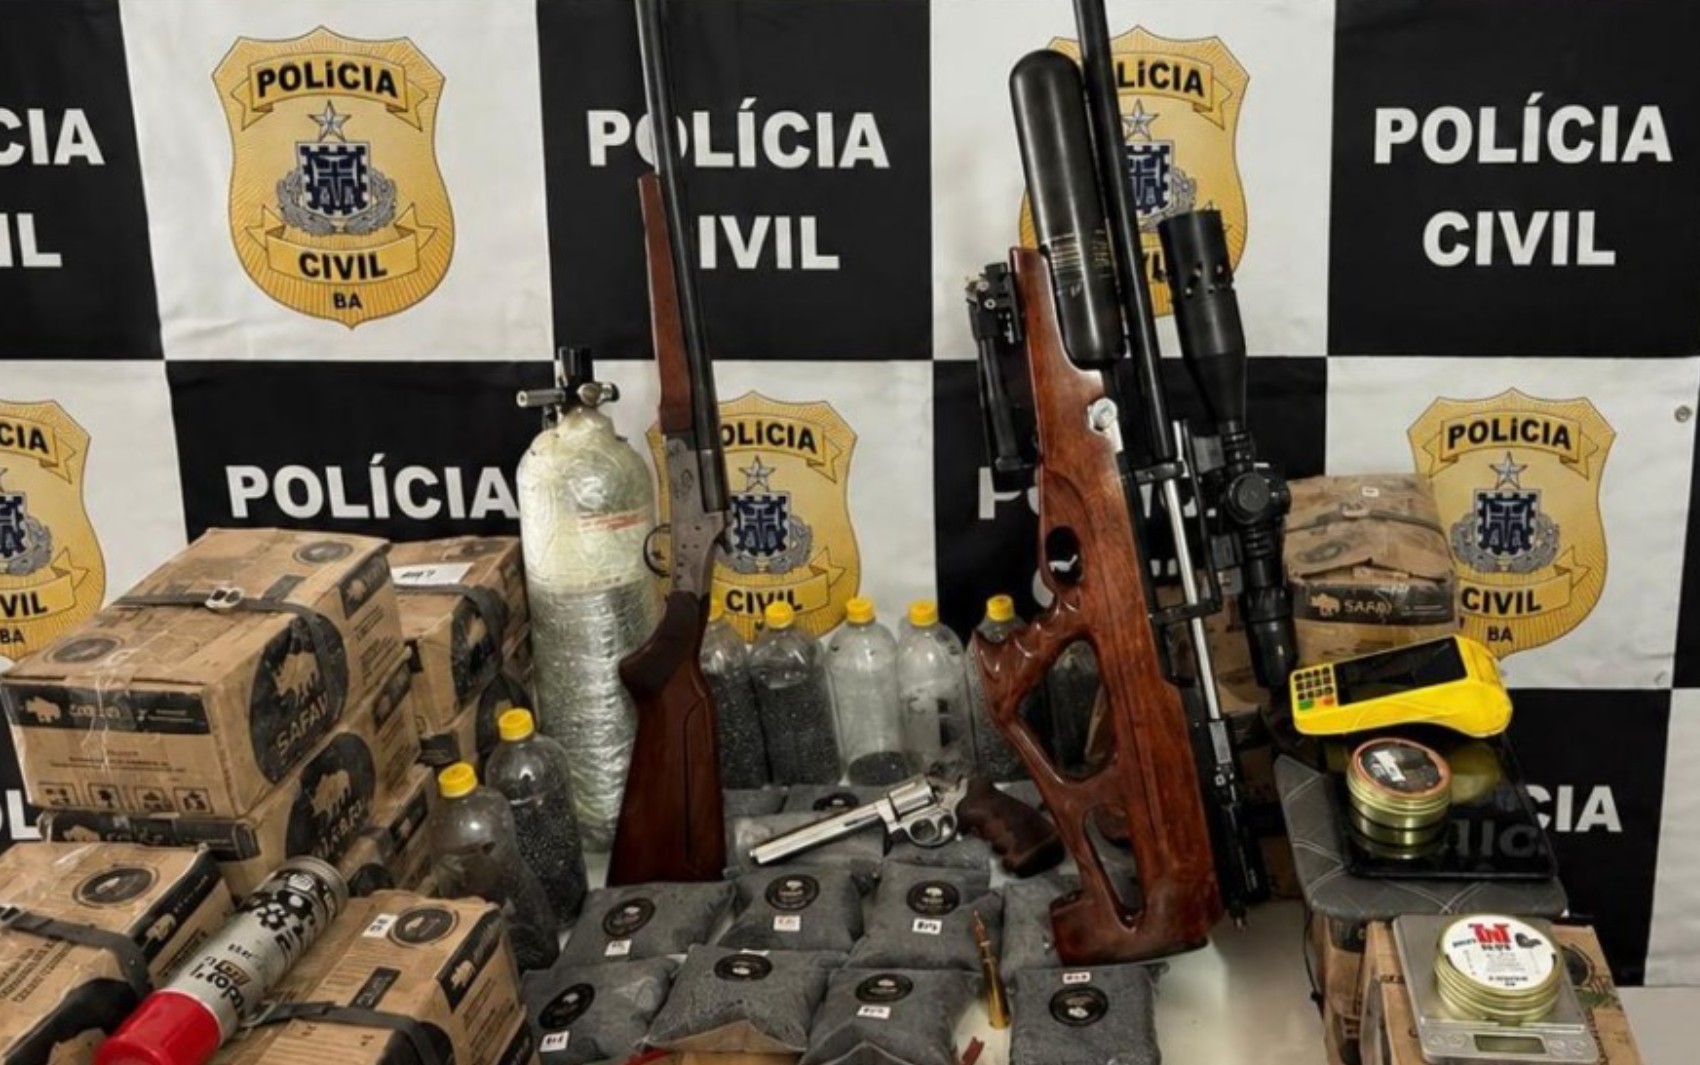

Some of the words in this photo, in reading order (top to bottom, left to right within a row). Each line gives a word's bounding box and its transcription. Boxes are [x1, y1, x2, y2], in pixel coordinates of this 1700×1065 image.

[1374, 92, 1673, 164] POLÍCIA
[698, 215, 841, 270] IVIL
[1423, 211, 1616, 266] CIVIL
[299, 251, 388, 279] CIVIL
[333, 293, 362, 309] BA
[225, 453, 519, 518] POLÍCIA
[1461, 587, 1542, 614] CIVIL
[0, 627, 26, 645] BA
[1487, 626, 1513, 642] BA
